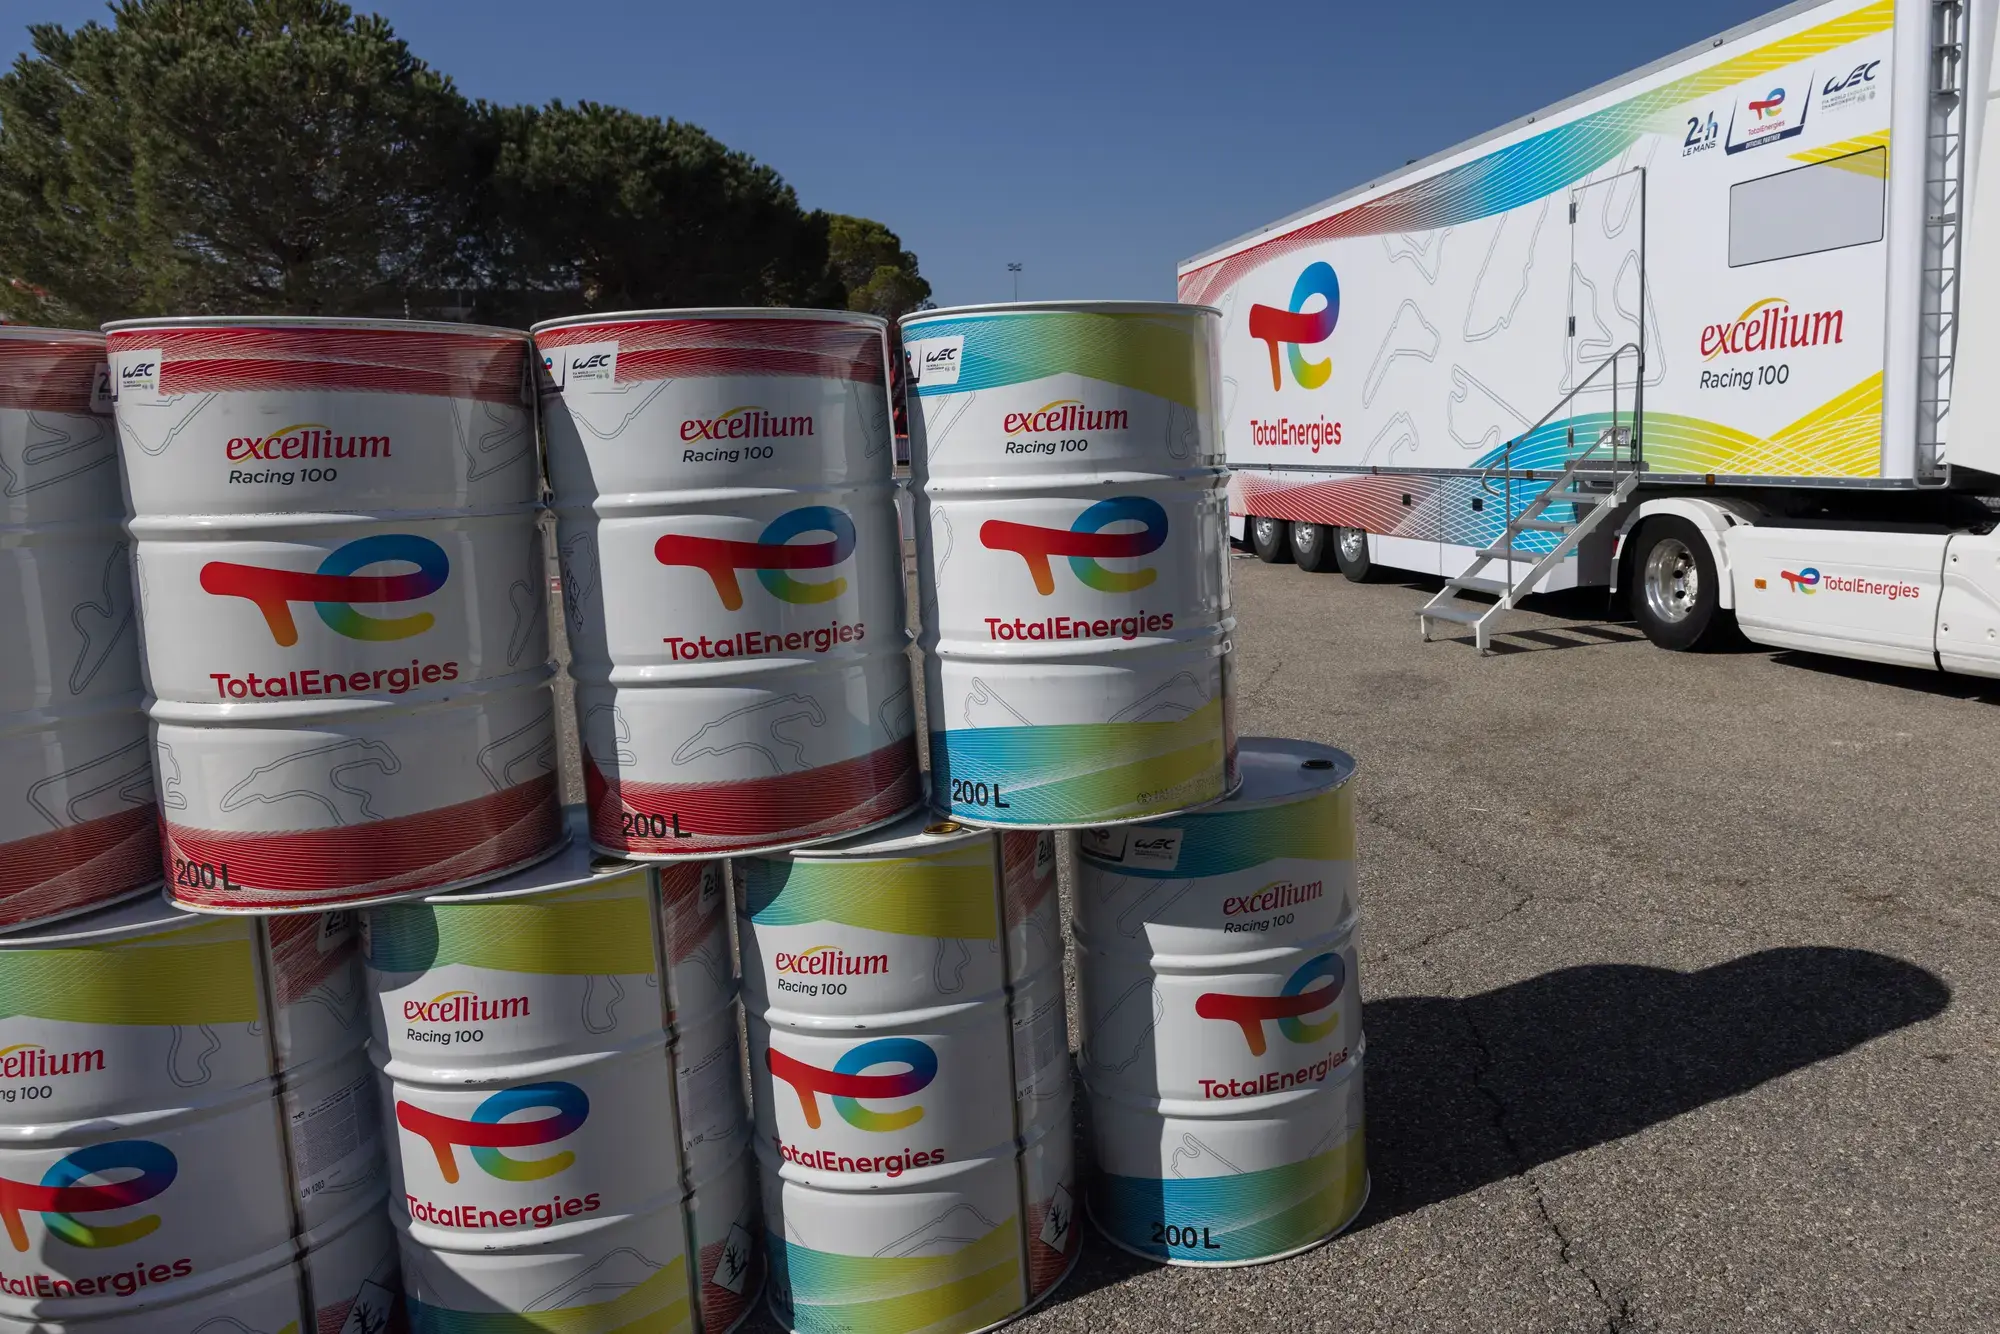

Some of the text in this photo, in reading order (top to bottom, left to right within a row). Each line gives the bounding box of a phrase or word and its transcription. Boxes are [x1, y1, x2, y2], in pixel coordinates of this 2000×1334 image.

[1822, 59, 1881, 96] WEC
[1684, 110, 1718, 148] 24h
[1748, 119, 1786, 136] TotalEnergies
[1763, 133, 1781, 144] PARTNER
[1682, 140, 1716, 157] LE MANS
[1700, 304, 1844, 356] excellium
[572, 354, 611, 370] WEC
[926, 348, 958, 363] WEC
[123, 363, 155, 378] WEC
[1700, 364, 1789, 390] Racing 100
[680, 411, 814, 441] excellium
[1003, 404, 1129, 433] excellium
[226, 429, 392, 461] excellium
[1005, 439, 1088, 455] Racing 100
[1251, 414, 1342, 454] TotalEnergies
[682, 446, 774, 463] Racing 100
[229, 468, 337, 486] Racing 100
[1823, 575, 1920, 600] TotalEnergies
[984, 609, 1174, 641] TotalEnergies
[663, 620, 865, 660] TotalEnergies
[210, 659, 459, 699] TotalEnergies
[952, 778, 1010, 809] 200 L
[621, 812, 692, 839] 200 L
[175, 858, 242, 891] 200 L
[1223, 879, 1323, 916] excellium
[1224, 913, 1295, 934] Racing 100
[776, 950, 889, 976] excellium
[778, 978, 847, 996] Racing 100
[404, 995, 530, 1022] excellium
[407, 1028, 484, 1045] Racing 100
[0, 1048, 106, 1078] ellium
[1198, 1047, 1348, 1099] TotalEnergies
[20, 1085, 53, 1100] 100
[772, 1136, 945, 1177] TotalEnergies
[406, 1192, 601, 1228] TotalEnergies
[1151, 1221, 1221, 1249] 200 L
